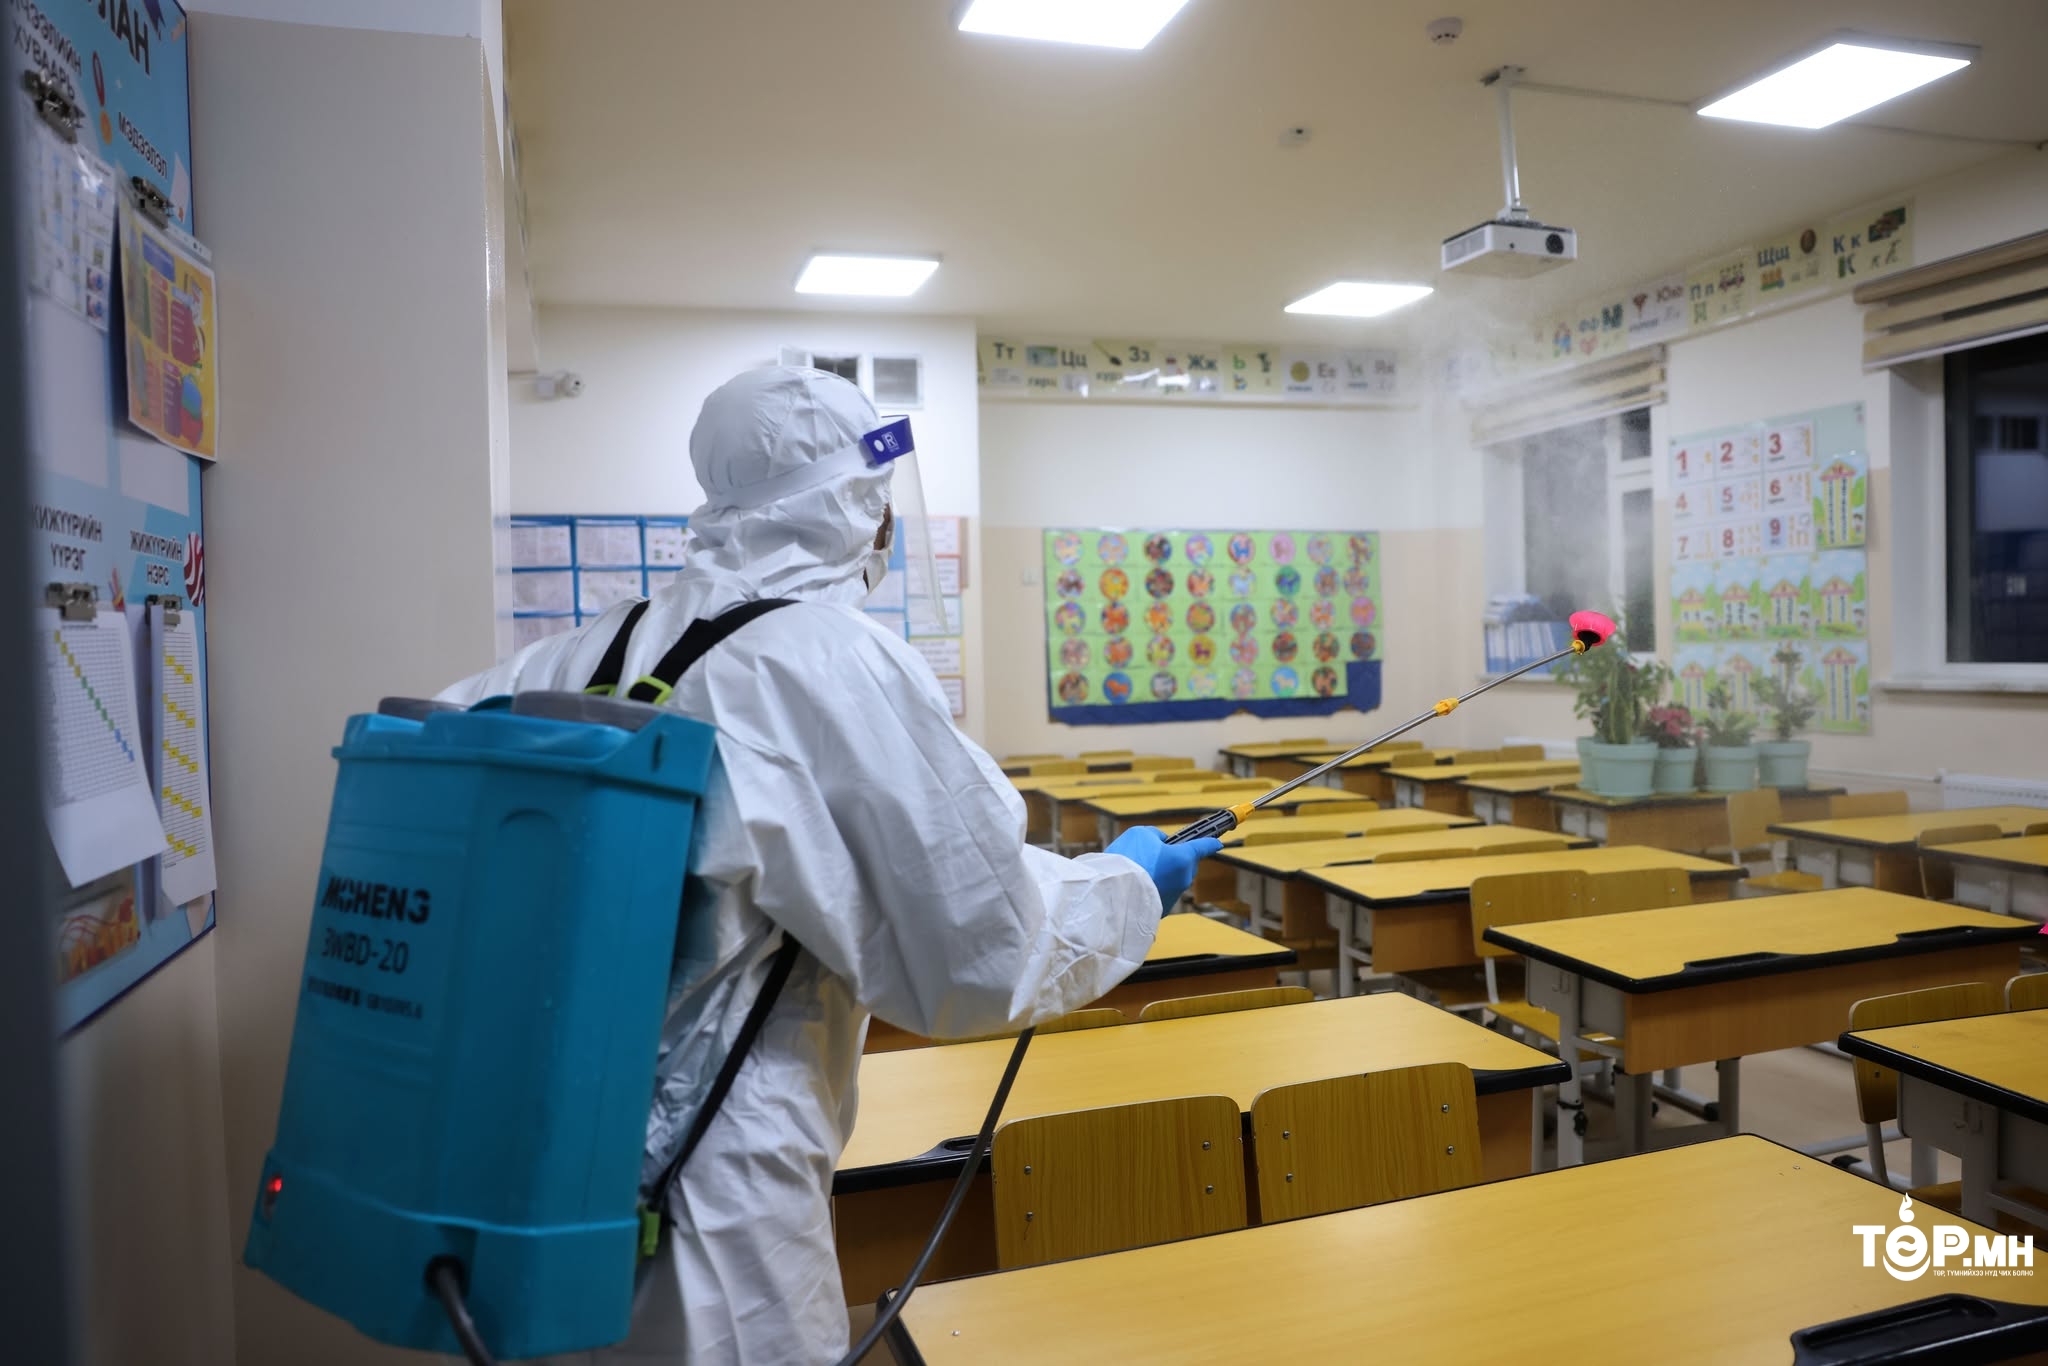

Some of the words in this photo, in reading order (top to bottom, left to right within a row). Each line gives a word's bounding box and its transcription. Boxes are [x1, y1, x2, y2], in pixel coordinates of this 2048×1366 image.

[118, 111, 169, 179] МЭДЭЭЛЭЛ
[1720, 440, 1733, 464] 2
[1768, 432, 1781, 456] 3
[1676, 449, 1687, 471] 1
[1769, 479, 1781, 497] 6
[1723, 528, 1735, 549] 8
[1769, 518, 1781, 538] 9
[51, 542, 85, 571] ҮҮРЭГ
[147, 564, 169, 586] НЭРС
